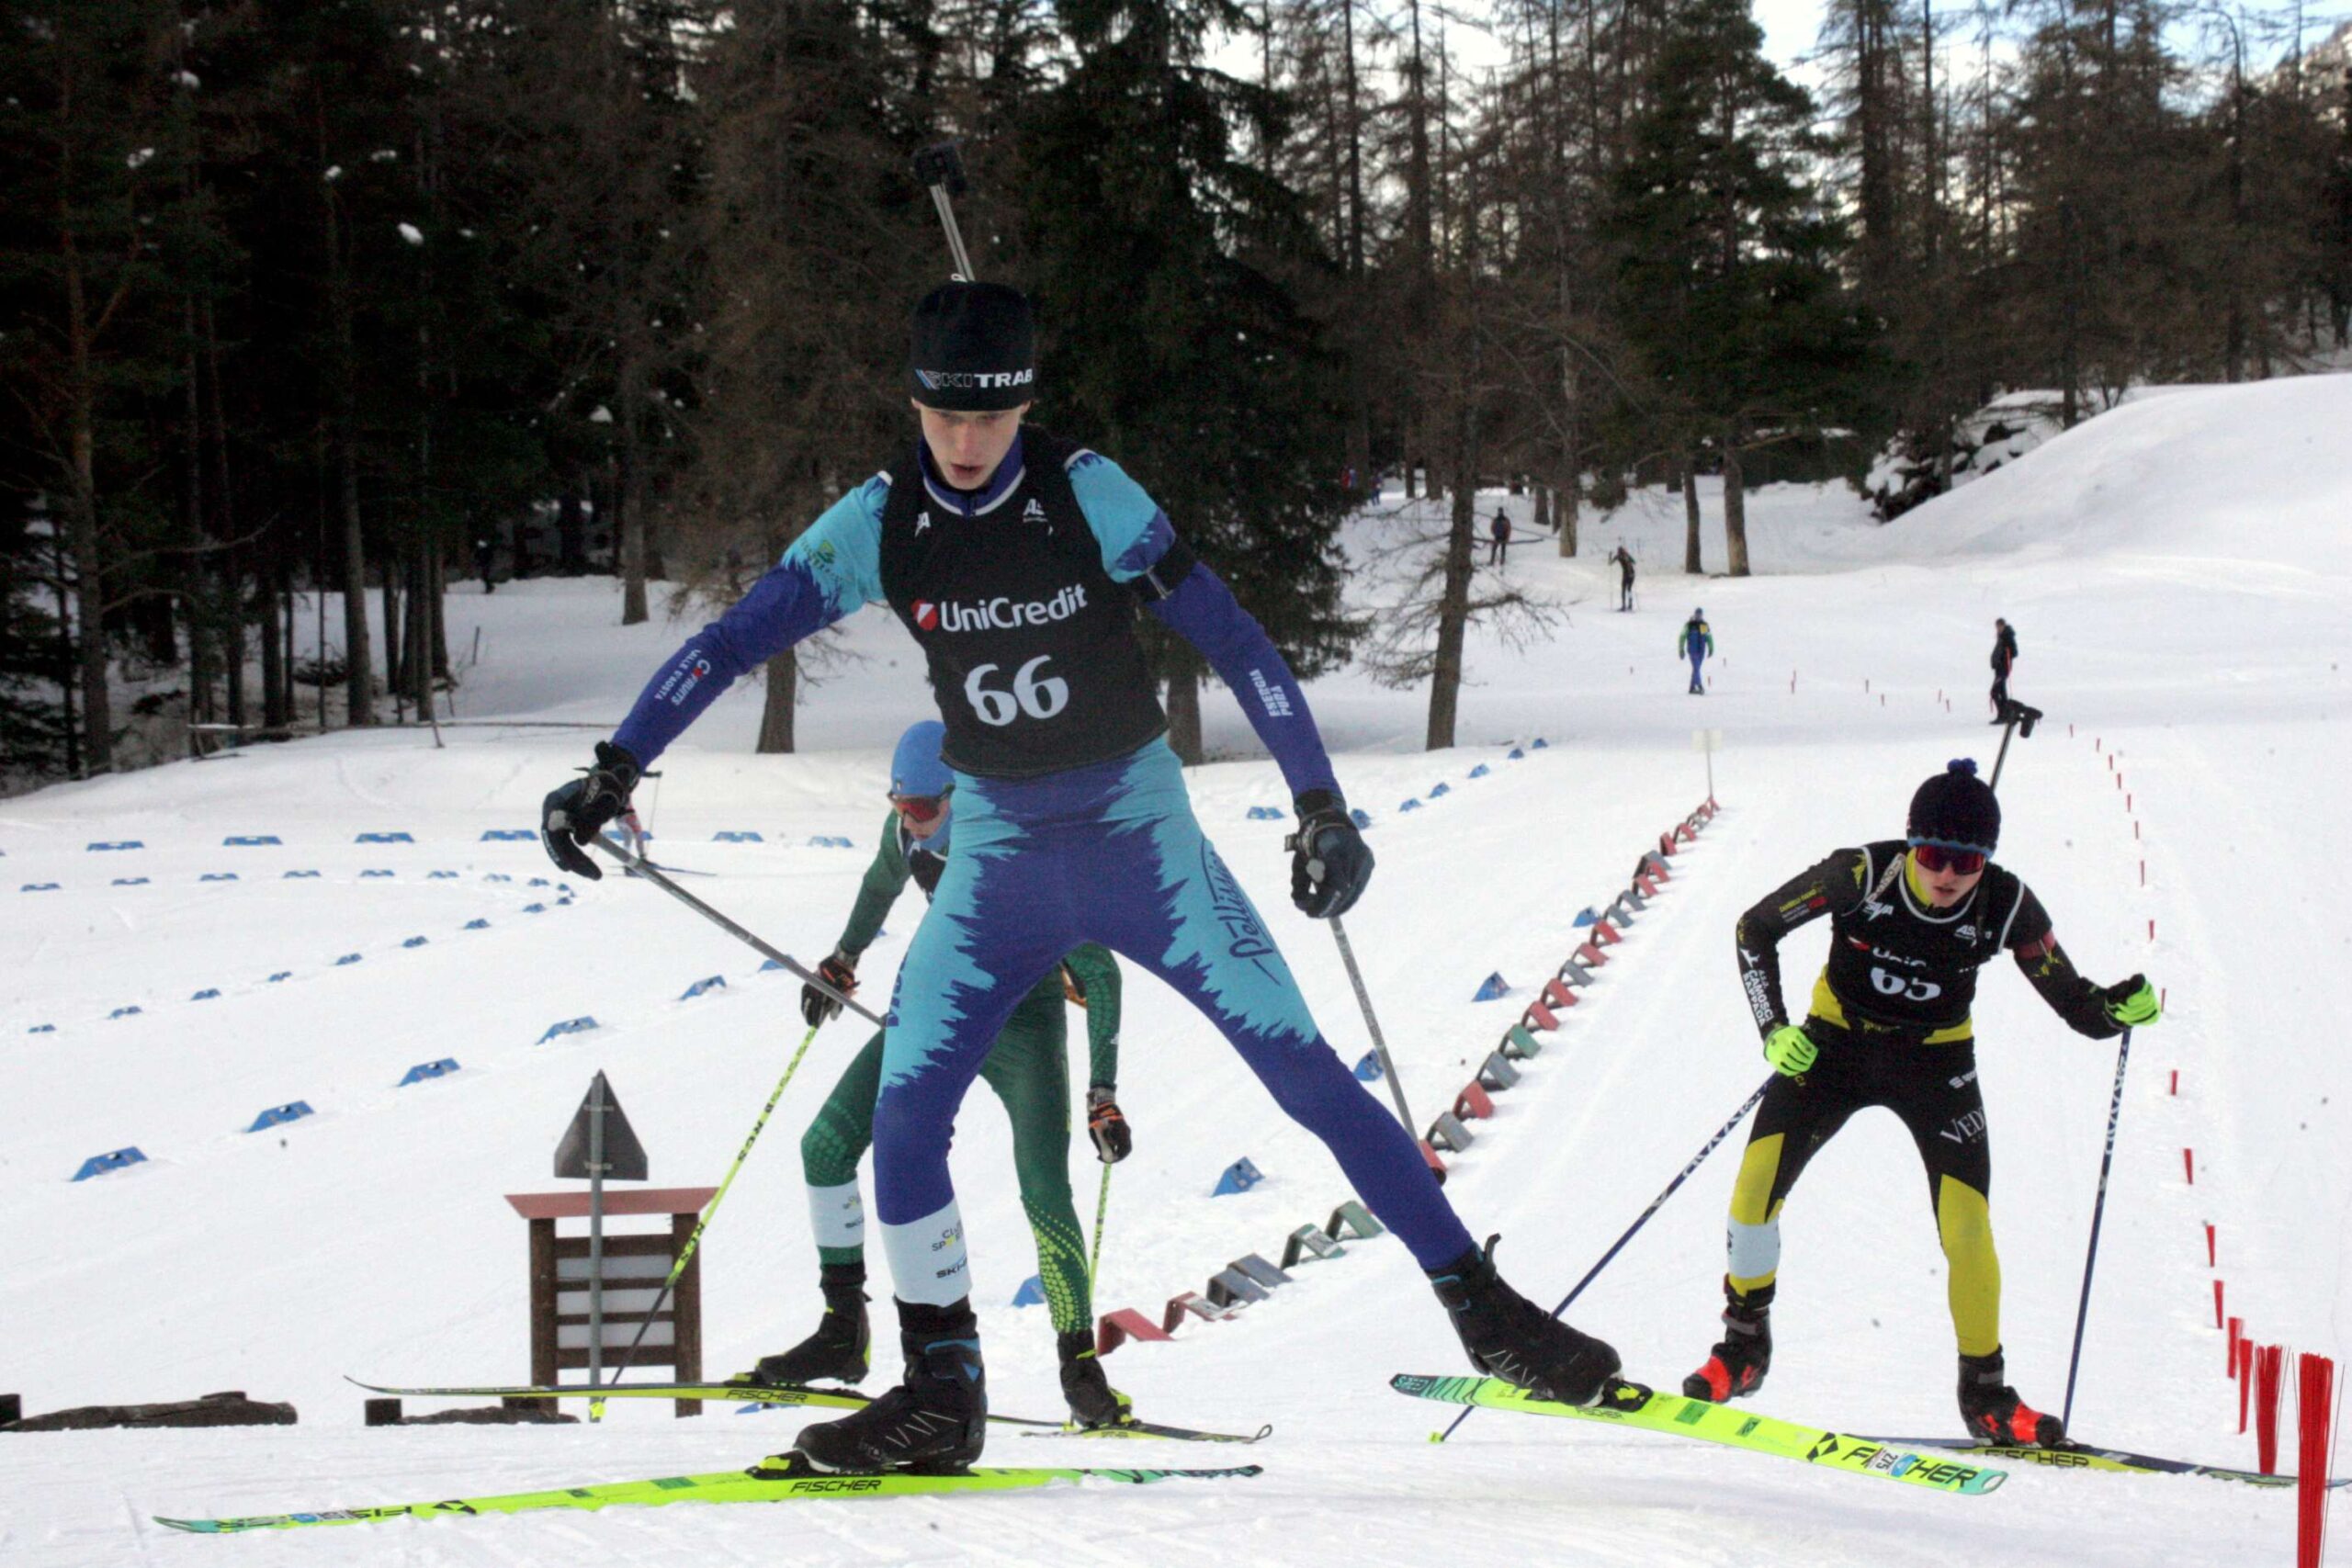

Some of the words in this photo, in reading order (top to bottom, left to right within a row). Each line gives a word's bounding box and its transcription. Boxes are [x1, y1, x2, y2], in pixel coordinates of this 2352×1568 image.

[941, 583, 1088, 632] UniCredit
[964, 654, 1069, 726] 66
[1743, 973, 1766, 1027] SAPPADA
[1747, 969, 1774, 1022] CAMOSCI
[1871, 966, 1941, 1001] 65
[725, 1389, 808, 1403] FISCHER
[790, 1480, 882, 1494] FISCHER
[1841, 1447, 1978, 1488] FIHER
